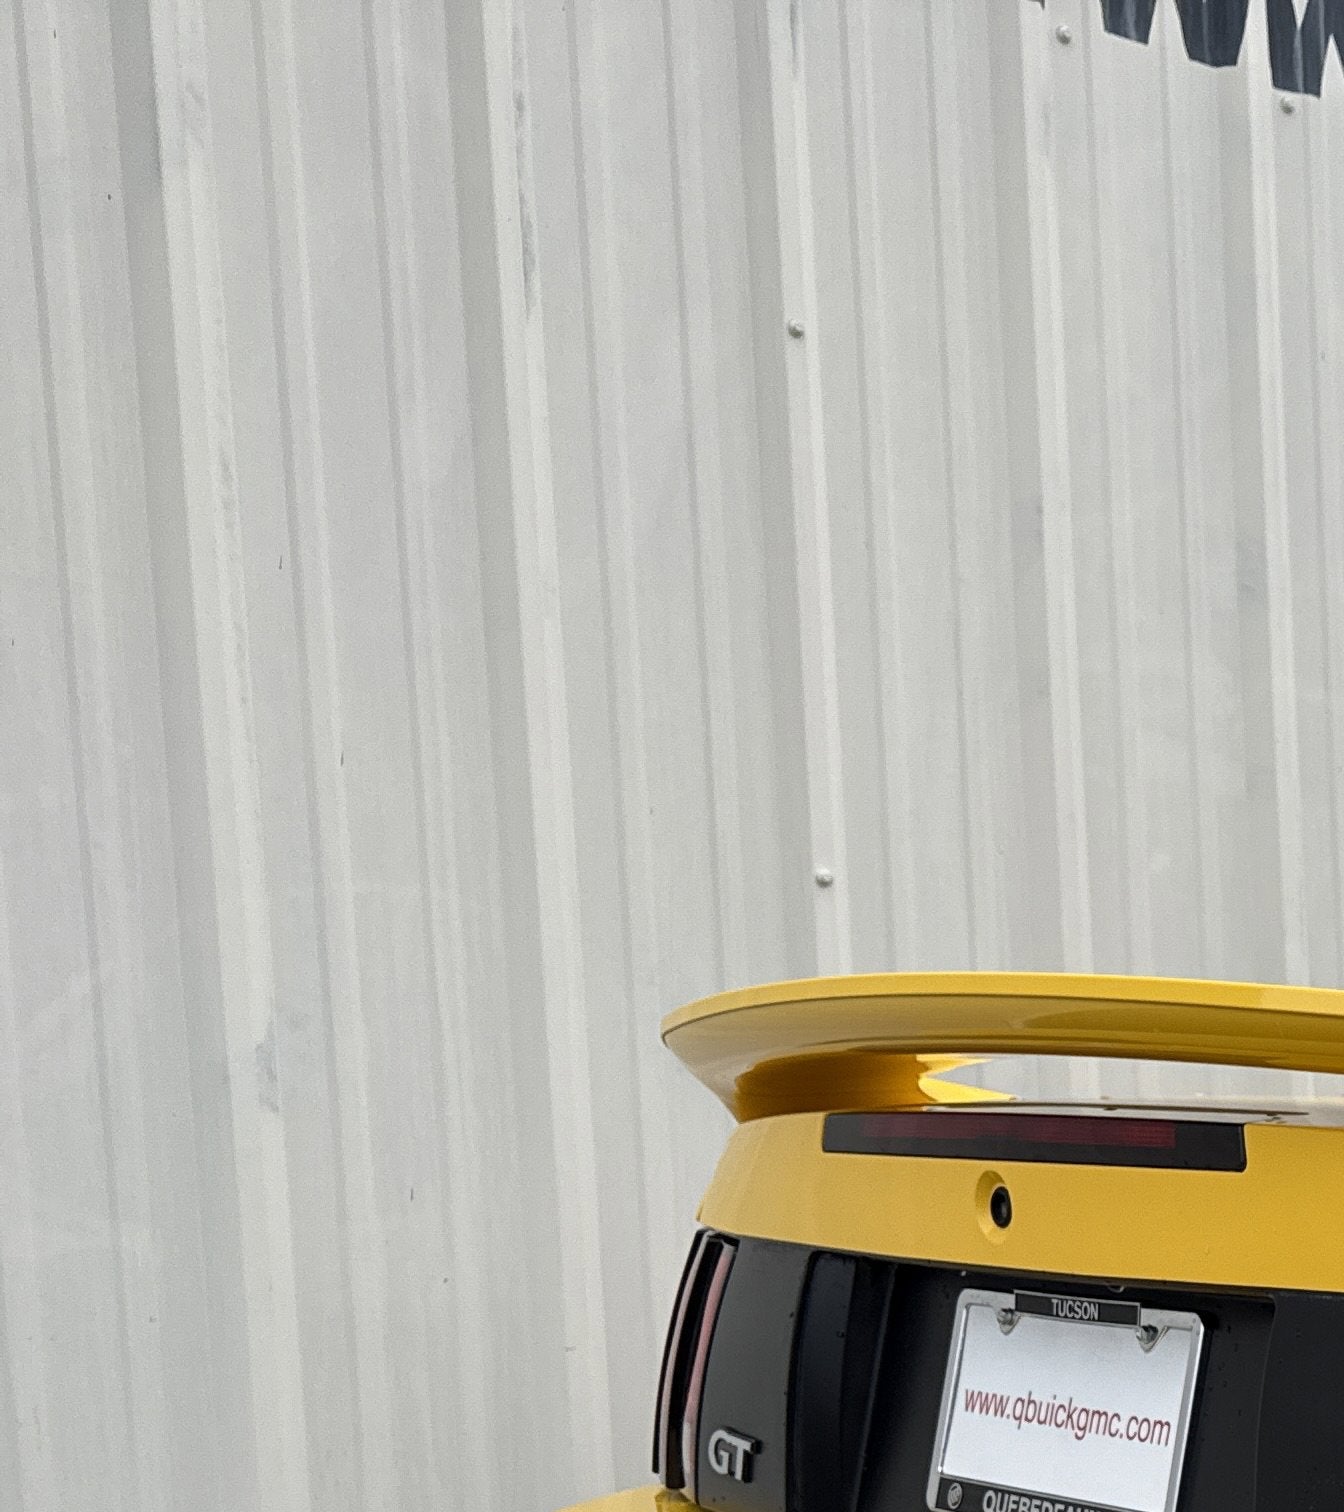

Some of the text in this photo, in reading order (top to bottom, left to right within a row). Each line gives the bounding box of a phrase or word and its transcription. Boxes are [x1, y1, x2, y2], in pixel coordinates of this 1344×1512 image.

[1051, 1299, 1099, 1321] TUCSON
[964, 1388, 1171, 1447] www.qbuickgmc.com
[708, 1428, 757, 1481] GT
